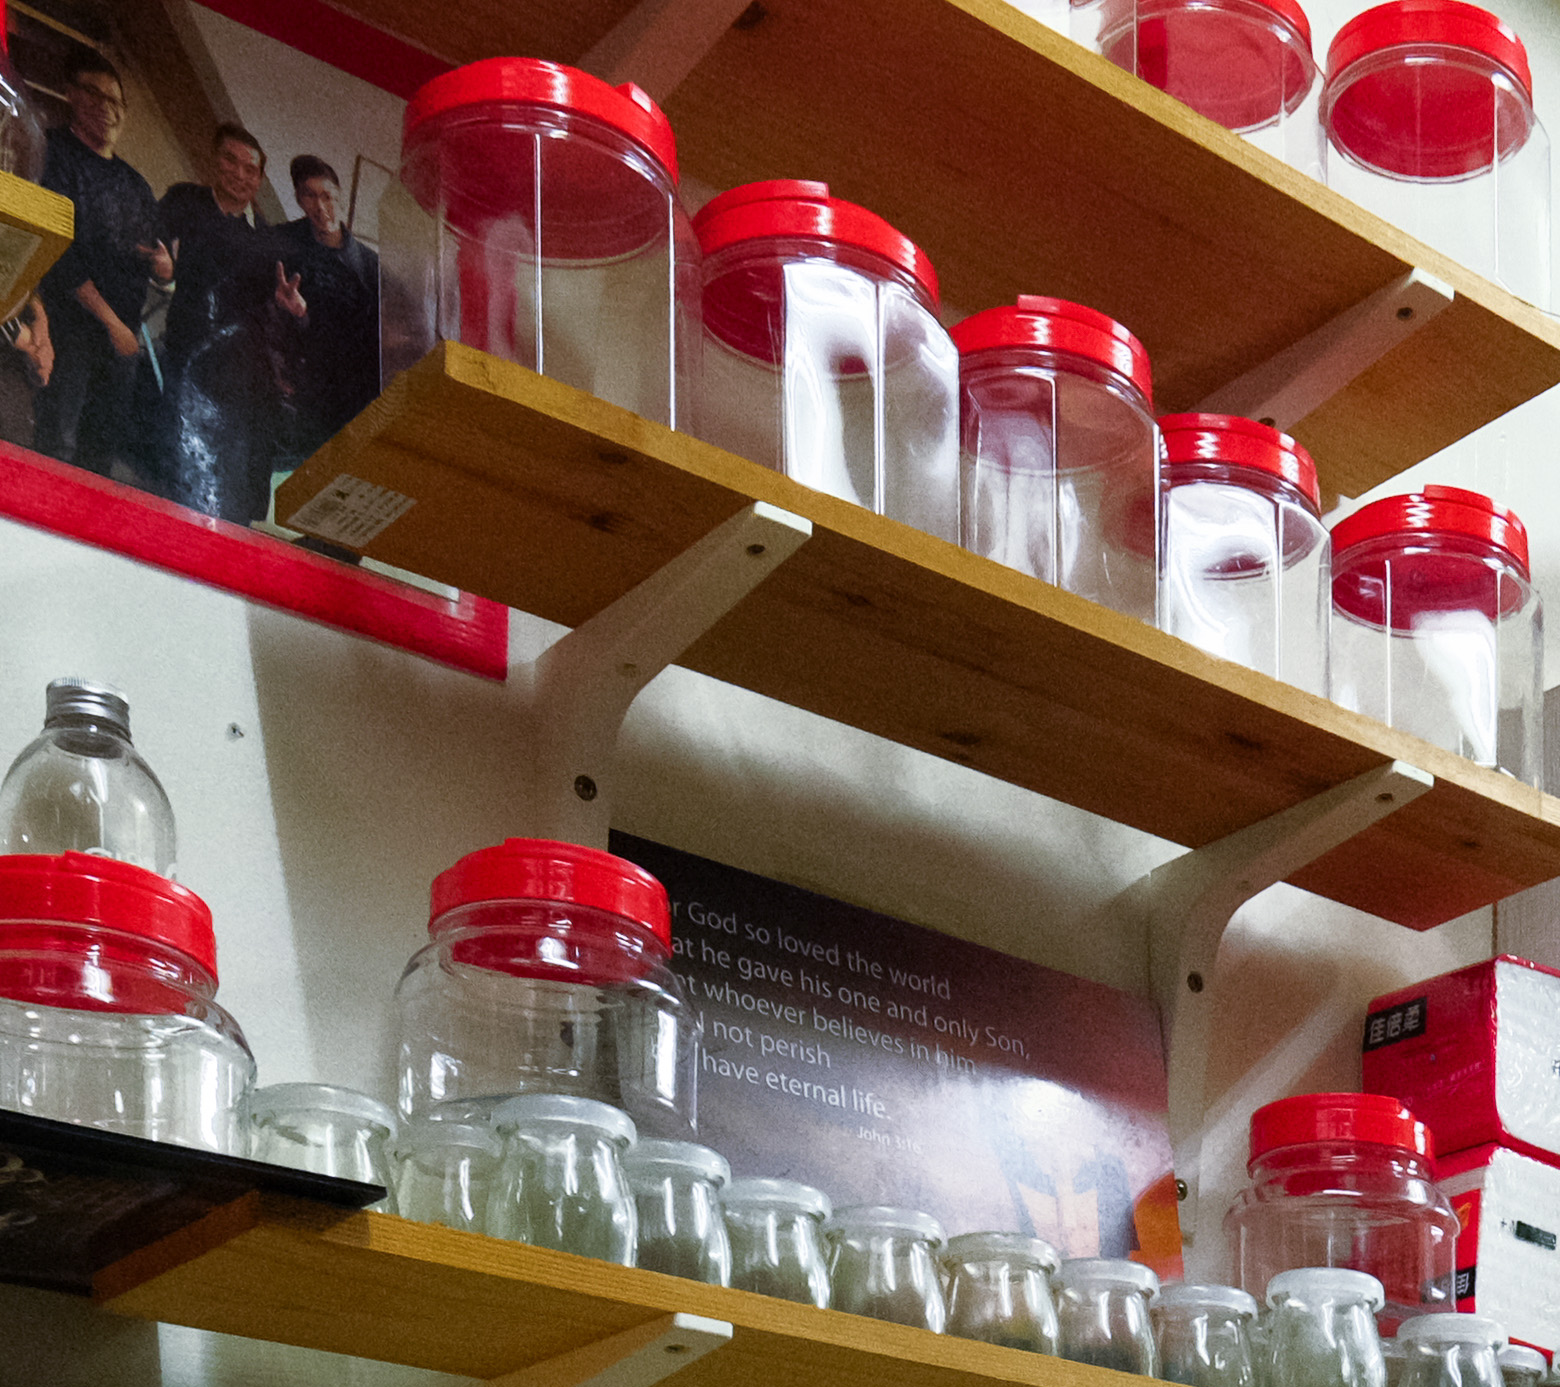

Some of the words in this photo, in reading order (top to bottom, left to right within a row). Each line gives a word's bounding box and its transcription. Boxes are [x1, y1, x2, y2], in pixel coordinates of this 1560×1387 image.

[688, 902, 737, 935] God
[744, 918, 770, 945] so
[778, 926, 839, 966] loved
[847, 950, 882, 979] the
[889, 966, 951, 1000] world
[701, 937, 730, 969] he
[738, 956, 793, 988] gave
[800, 962, 832, 997] his
[839, 986, 880, 1013] one
[887, 996, 927, 1026] and
[934, 1010, 978, 1047] only
[985, 1025, 1031, 1060] Son,
[704, 980, 806, 1024] whoever
[813, 1002, 904, 1055] believes
[910, 1035, 929, 1060] in
[934, 1041, 977, 1075] him
[702, 1046, 759, 1084] have
[765, 1070, 846, 1108] eternal
[852, 1088, 892, 1120] life.
[713, 1018, 753, 1046] not
[760, 1031, 831, 1068] perish
[857, 1125, 891, 1148] John
